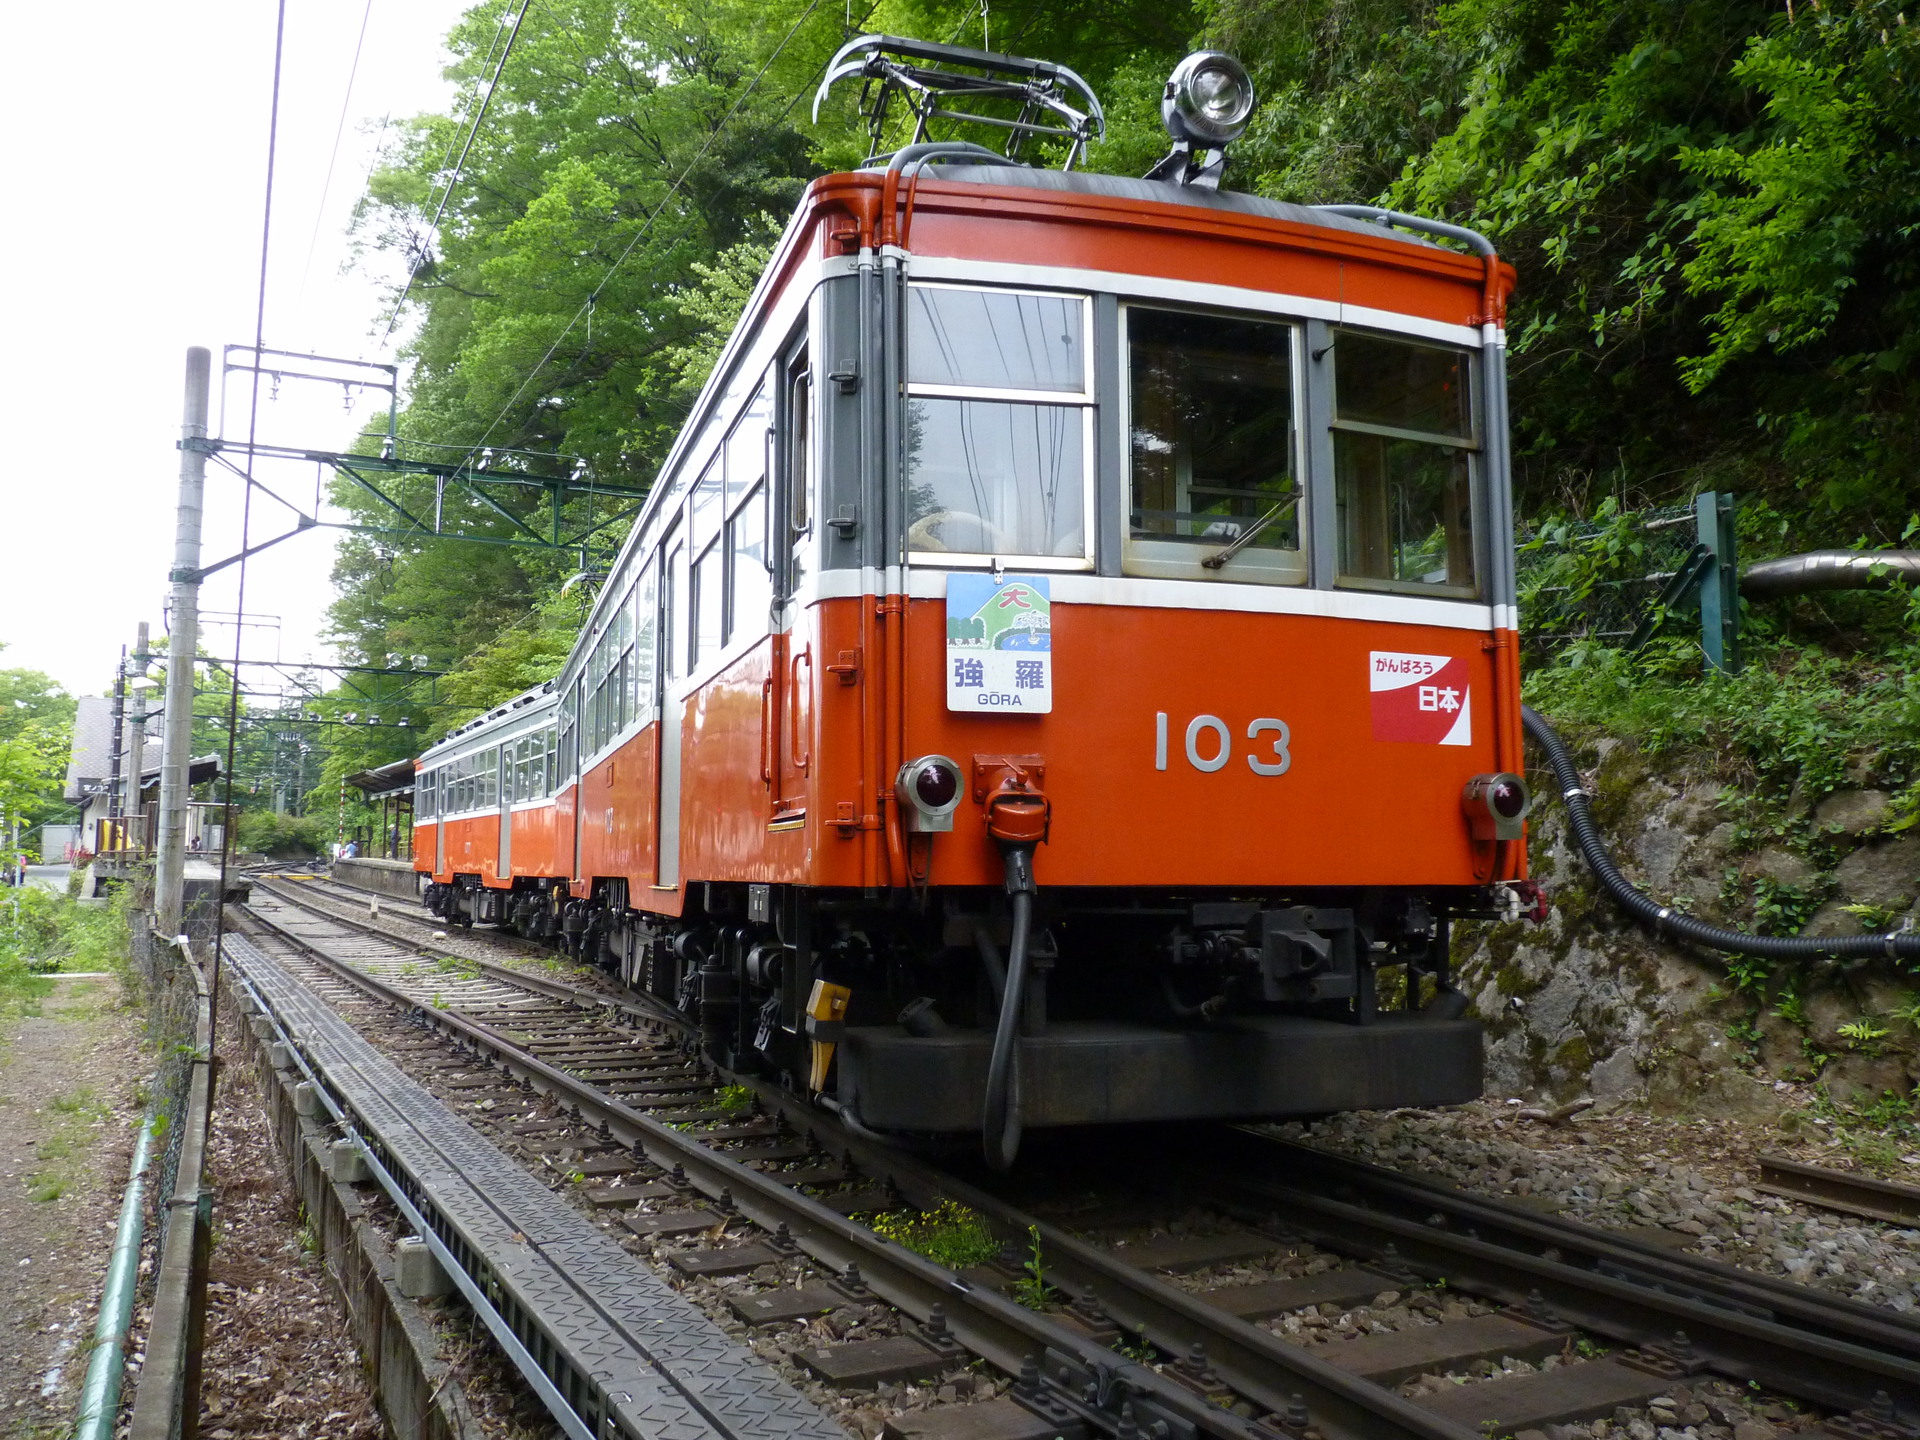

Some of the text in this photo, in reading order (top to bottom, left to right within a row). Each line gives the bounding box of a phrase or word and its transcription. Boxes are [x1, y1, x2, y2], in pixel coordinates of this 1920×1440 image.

[998, 588, 1031, 608] 大
[953, 658, 1045, 689] 強羅
[1376, 658, 1434, 675] がんばろう
[977, 691, 1023, 706] GŌRA
[1418, 685, 1460, 713] 日本
[1155, 711, 1292, 776] 103
